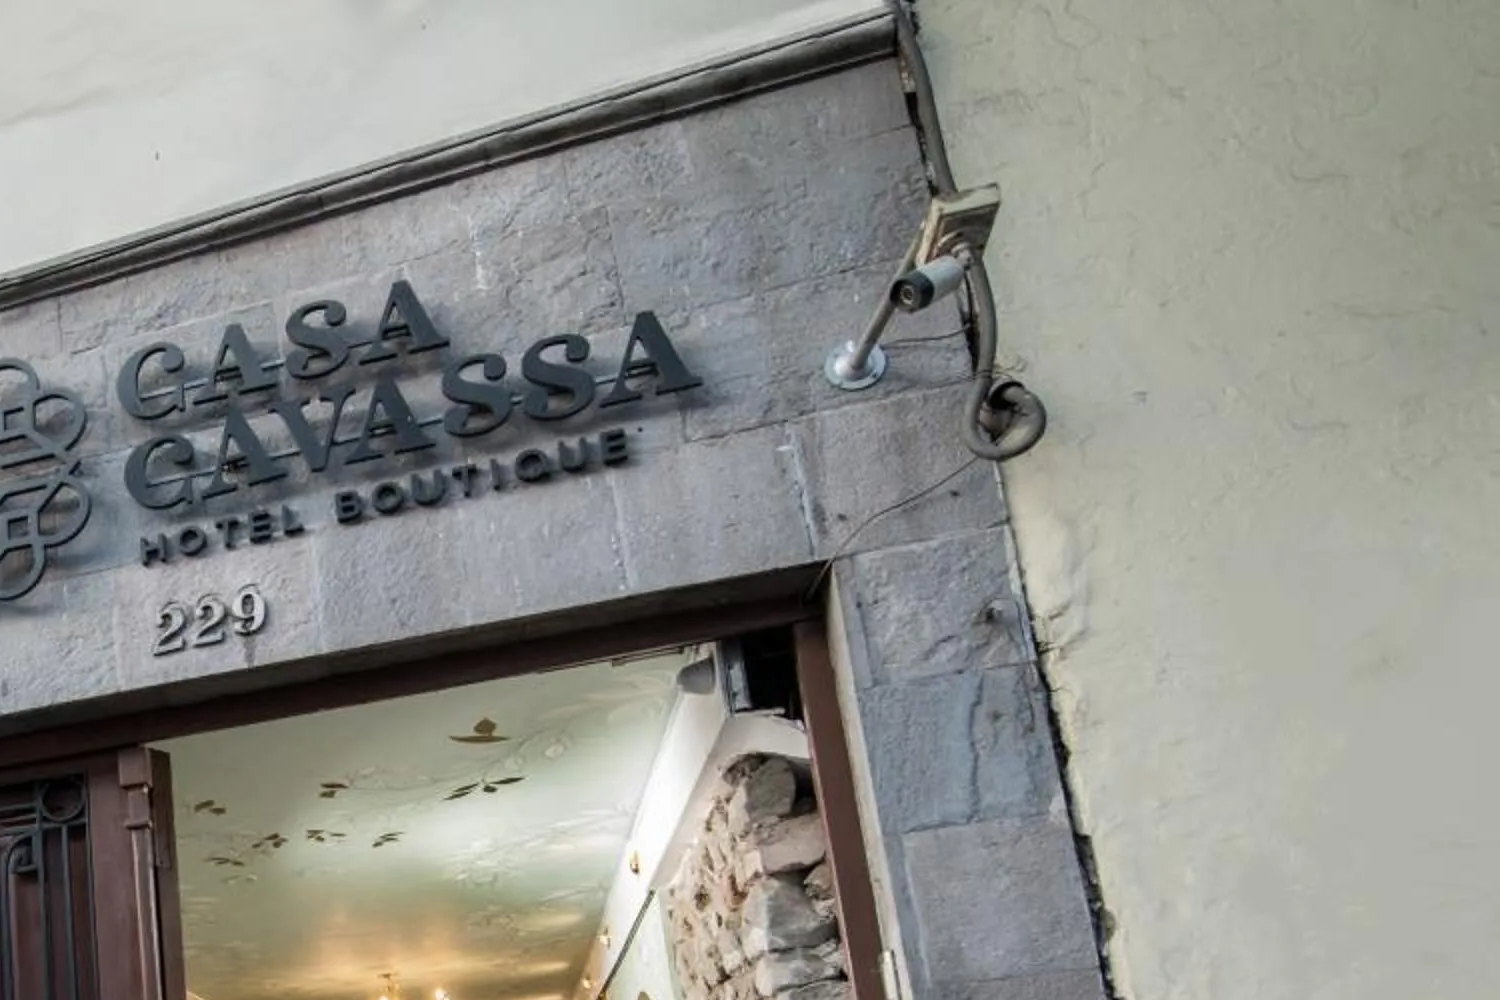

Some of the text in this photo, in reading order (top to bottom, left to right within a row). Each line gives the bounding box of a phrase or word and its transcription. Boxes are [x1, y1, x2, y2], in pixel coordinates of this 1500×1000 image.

[116, 279, 449, 421] CASA
[124, 310, 704, 511] CAVASSA
[140, 428, 629, 566] HOTEL BOUTIQUE
[153, 584, 268, 656] 229
